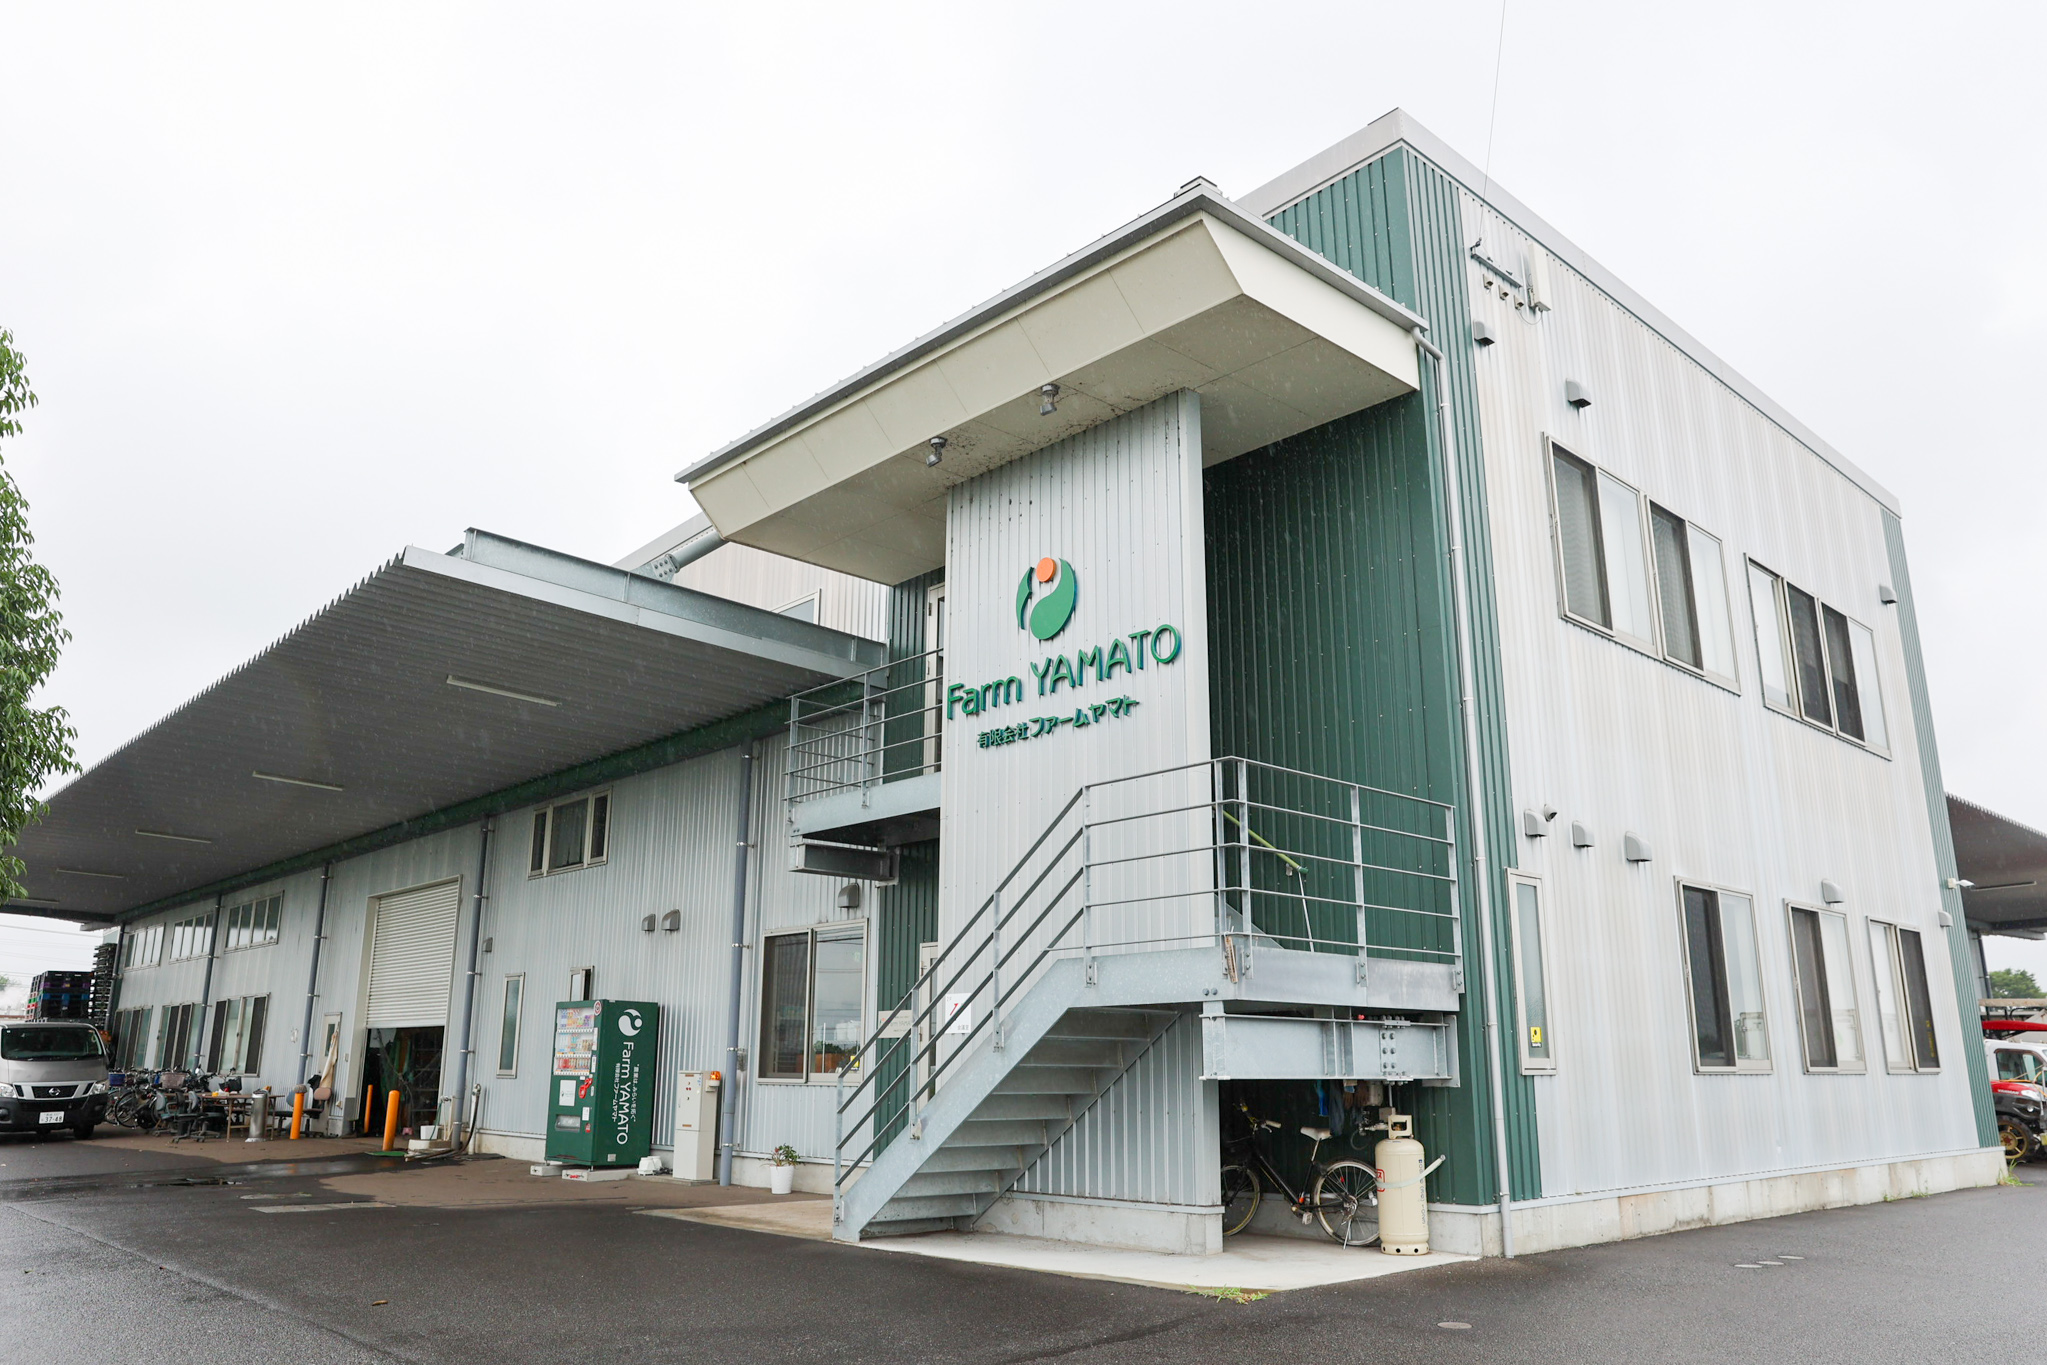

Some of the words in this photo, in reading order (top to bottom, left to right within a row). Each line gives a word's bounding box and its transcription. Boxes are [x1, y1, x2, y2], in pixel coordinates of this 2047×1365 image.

[947, 676, 1023, 720] Farm
[1031, 623, 1182, 696] YAMATO
[977, 694, 1140, 749] 有限会社ファームヤマト
[621, 1041, 634, 1078] Farm
[616, 1082, 631, 1145] YAMATO
